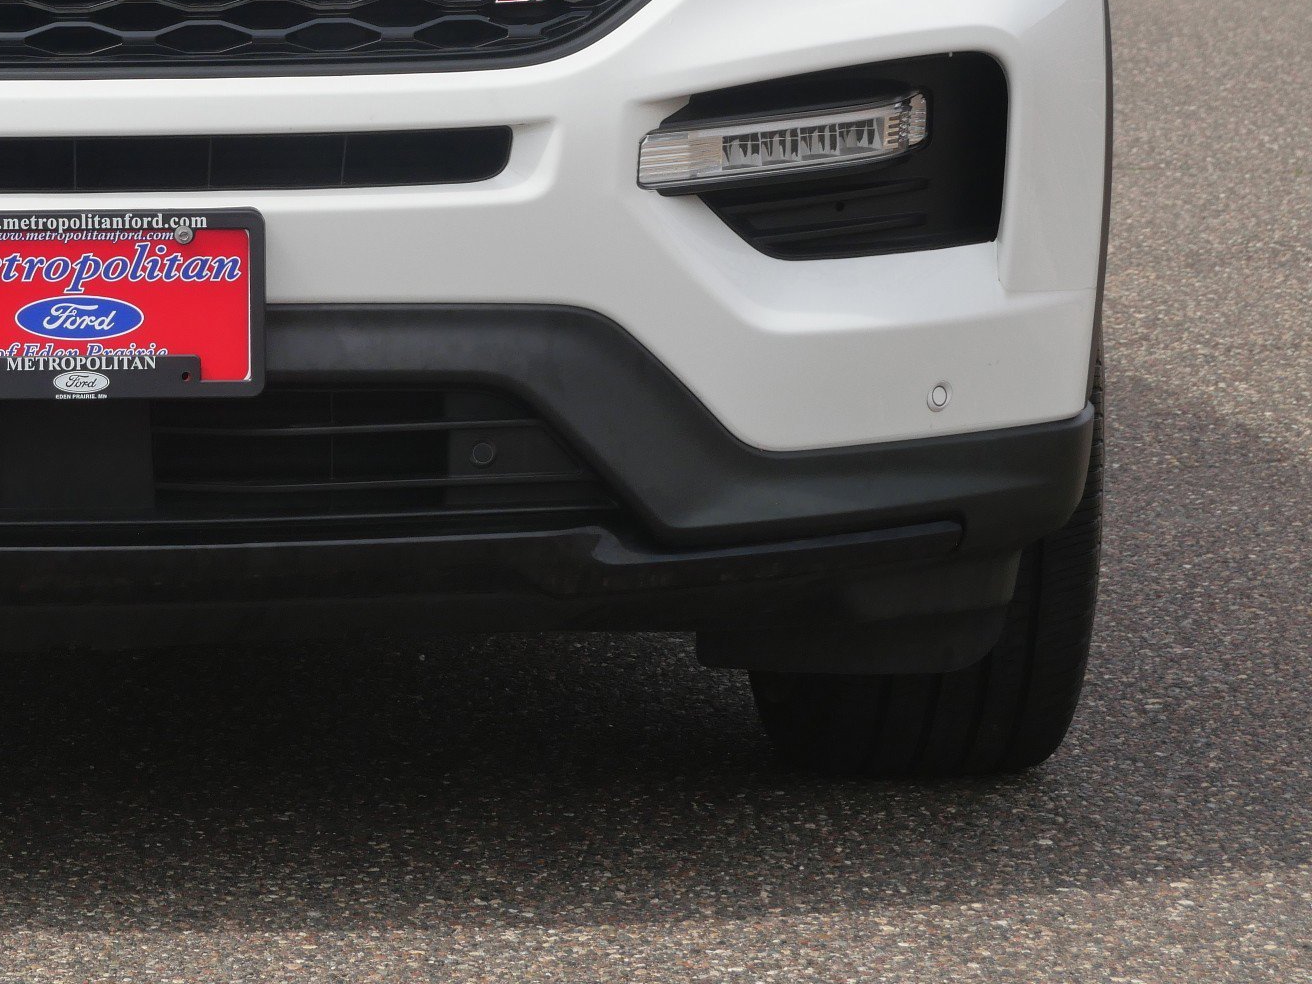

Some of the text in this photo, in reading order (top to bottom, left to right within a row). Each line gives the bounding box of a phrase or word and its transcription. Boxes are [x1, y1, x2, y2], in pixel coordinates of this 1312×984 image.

[42, 303, 117, 331] Ford
[6, 356, 157, 371] METROPOLITAN
[65, 375, 97, 387] Ford
